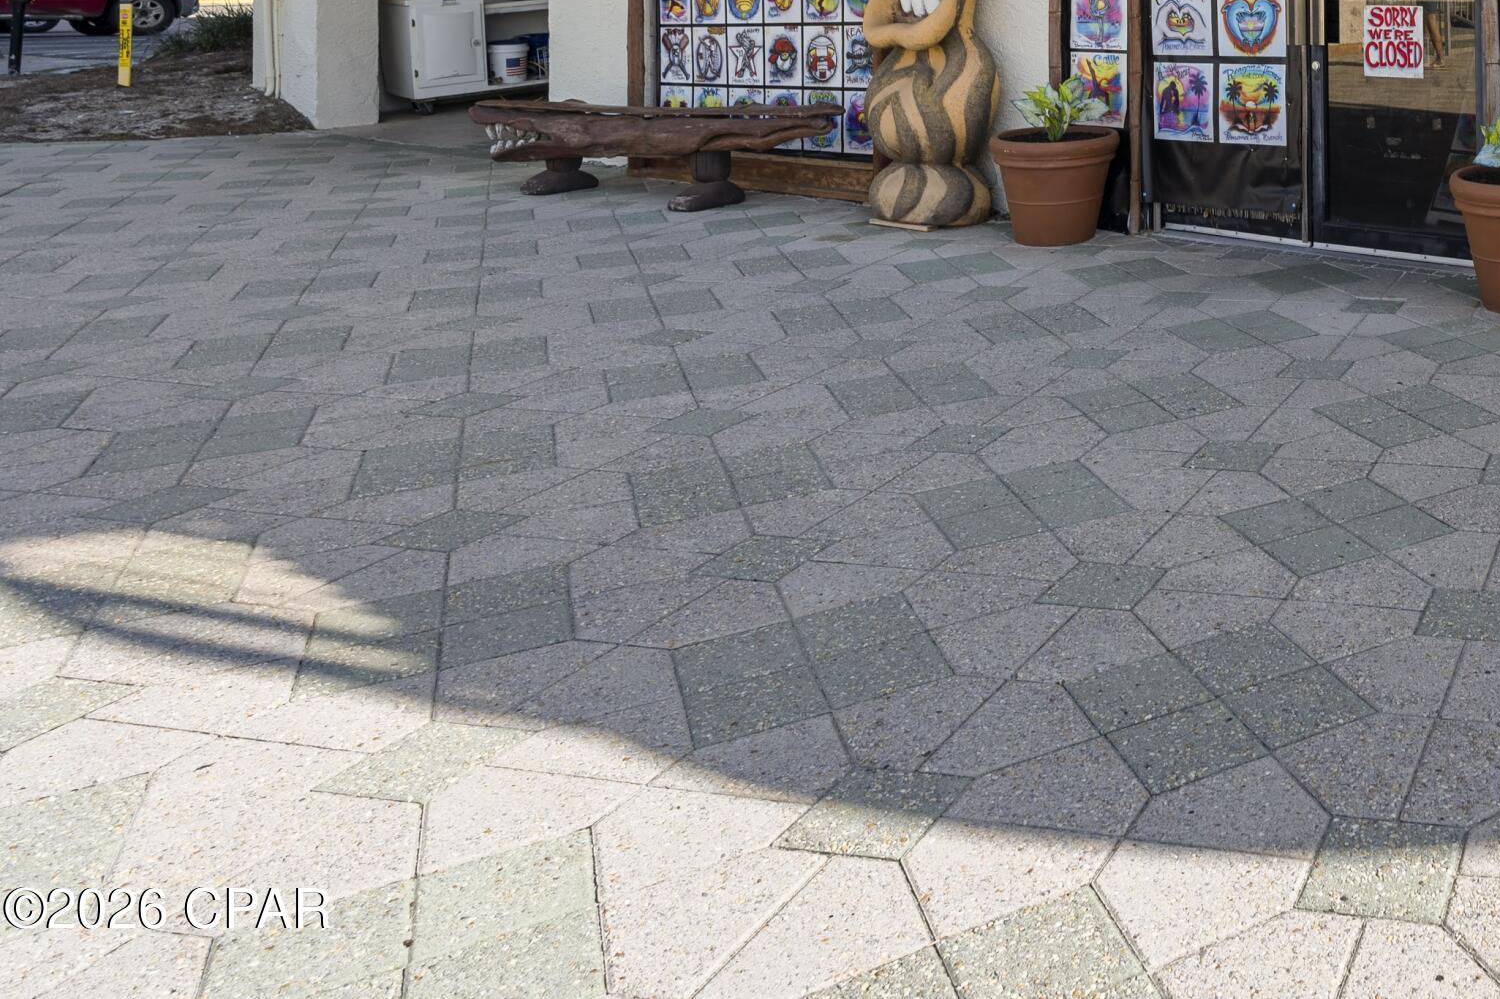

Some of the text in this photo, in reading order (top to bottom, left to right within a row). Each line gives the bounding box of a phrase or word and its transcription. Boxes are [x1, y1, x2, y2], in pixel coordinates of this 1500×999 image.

[1368, 7, 1418, 28] SORRY
[1368, 28, 1413, 41] WE'RE
[1364, 41, 1423, 69] CLOSED
